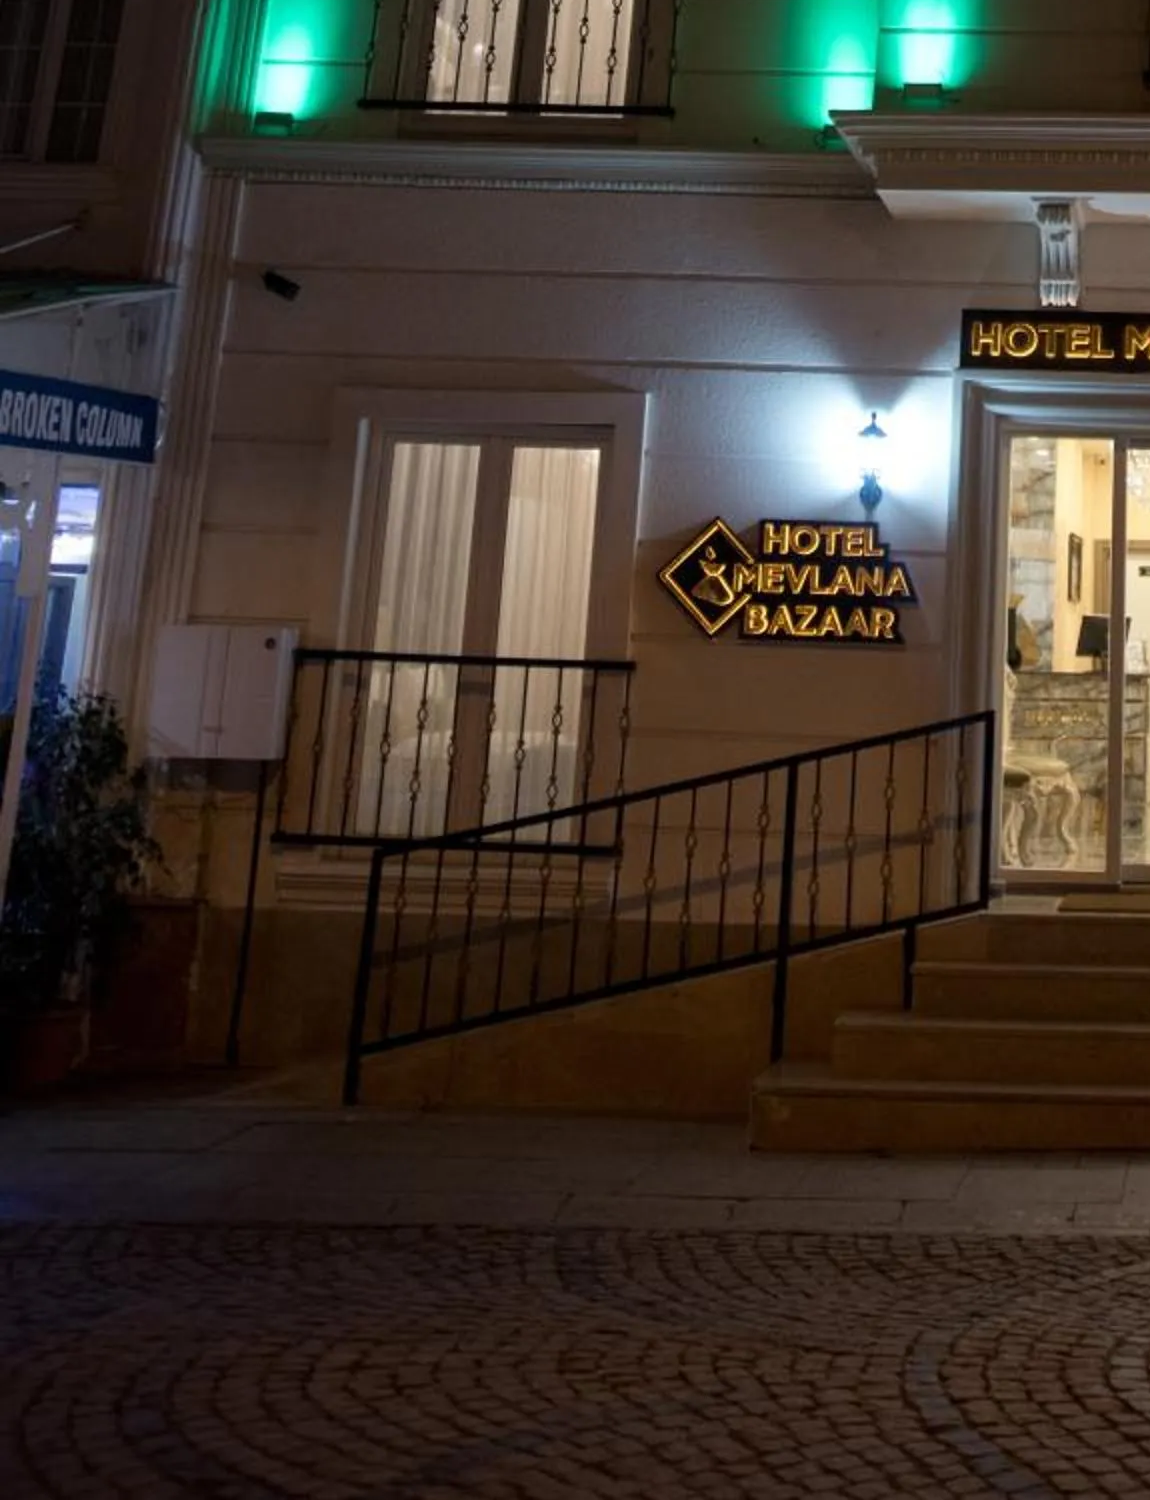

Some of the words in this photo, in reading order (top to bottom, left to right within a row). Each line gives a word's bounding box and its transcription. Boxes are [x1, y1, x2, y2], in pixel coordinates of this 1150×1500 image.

[970, 322, 1112, 358] HOTEL
[0, 388, 74, 442] BROKEN
[76, 401, 144, 448] COLUMN
[763, 522, 884, 558] HOTEL
[733, 562, 911, 597] MEVLANA
[748, 604, 896, 638] BAZAAR
